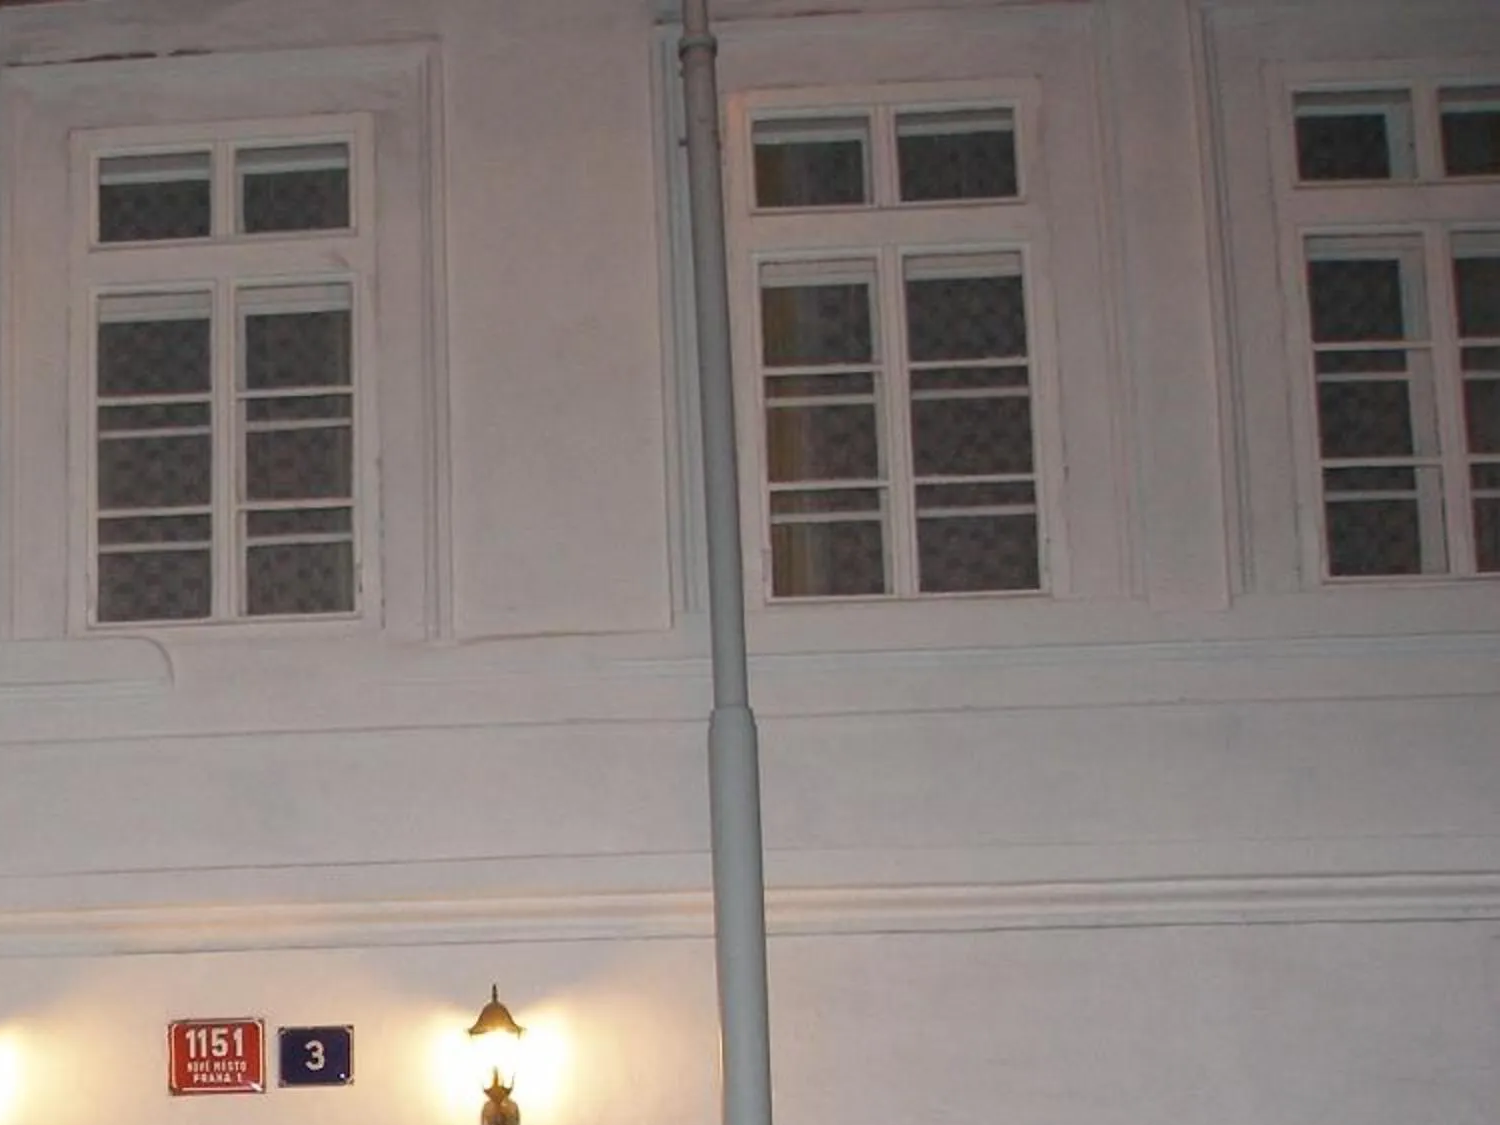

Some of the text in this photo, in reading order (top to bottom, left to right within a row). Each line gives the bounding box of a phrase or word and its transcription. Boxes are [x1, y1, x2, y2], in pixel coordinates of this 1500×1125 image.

[185, 1027, 244, 1059] 1151
[304, 1039, 326, 1071] 3
[193, 1072, 243, 1084] PRAHA 1
